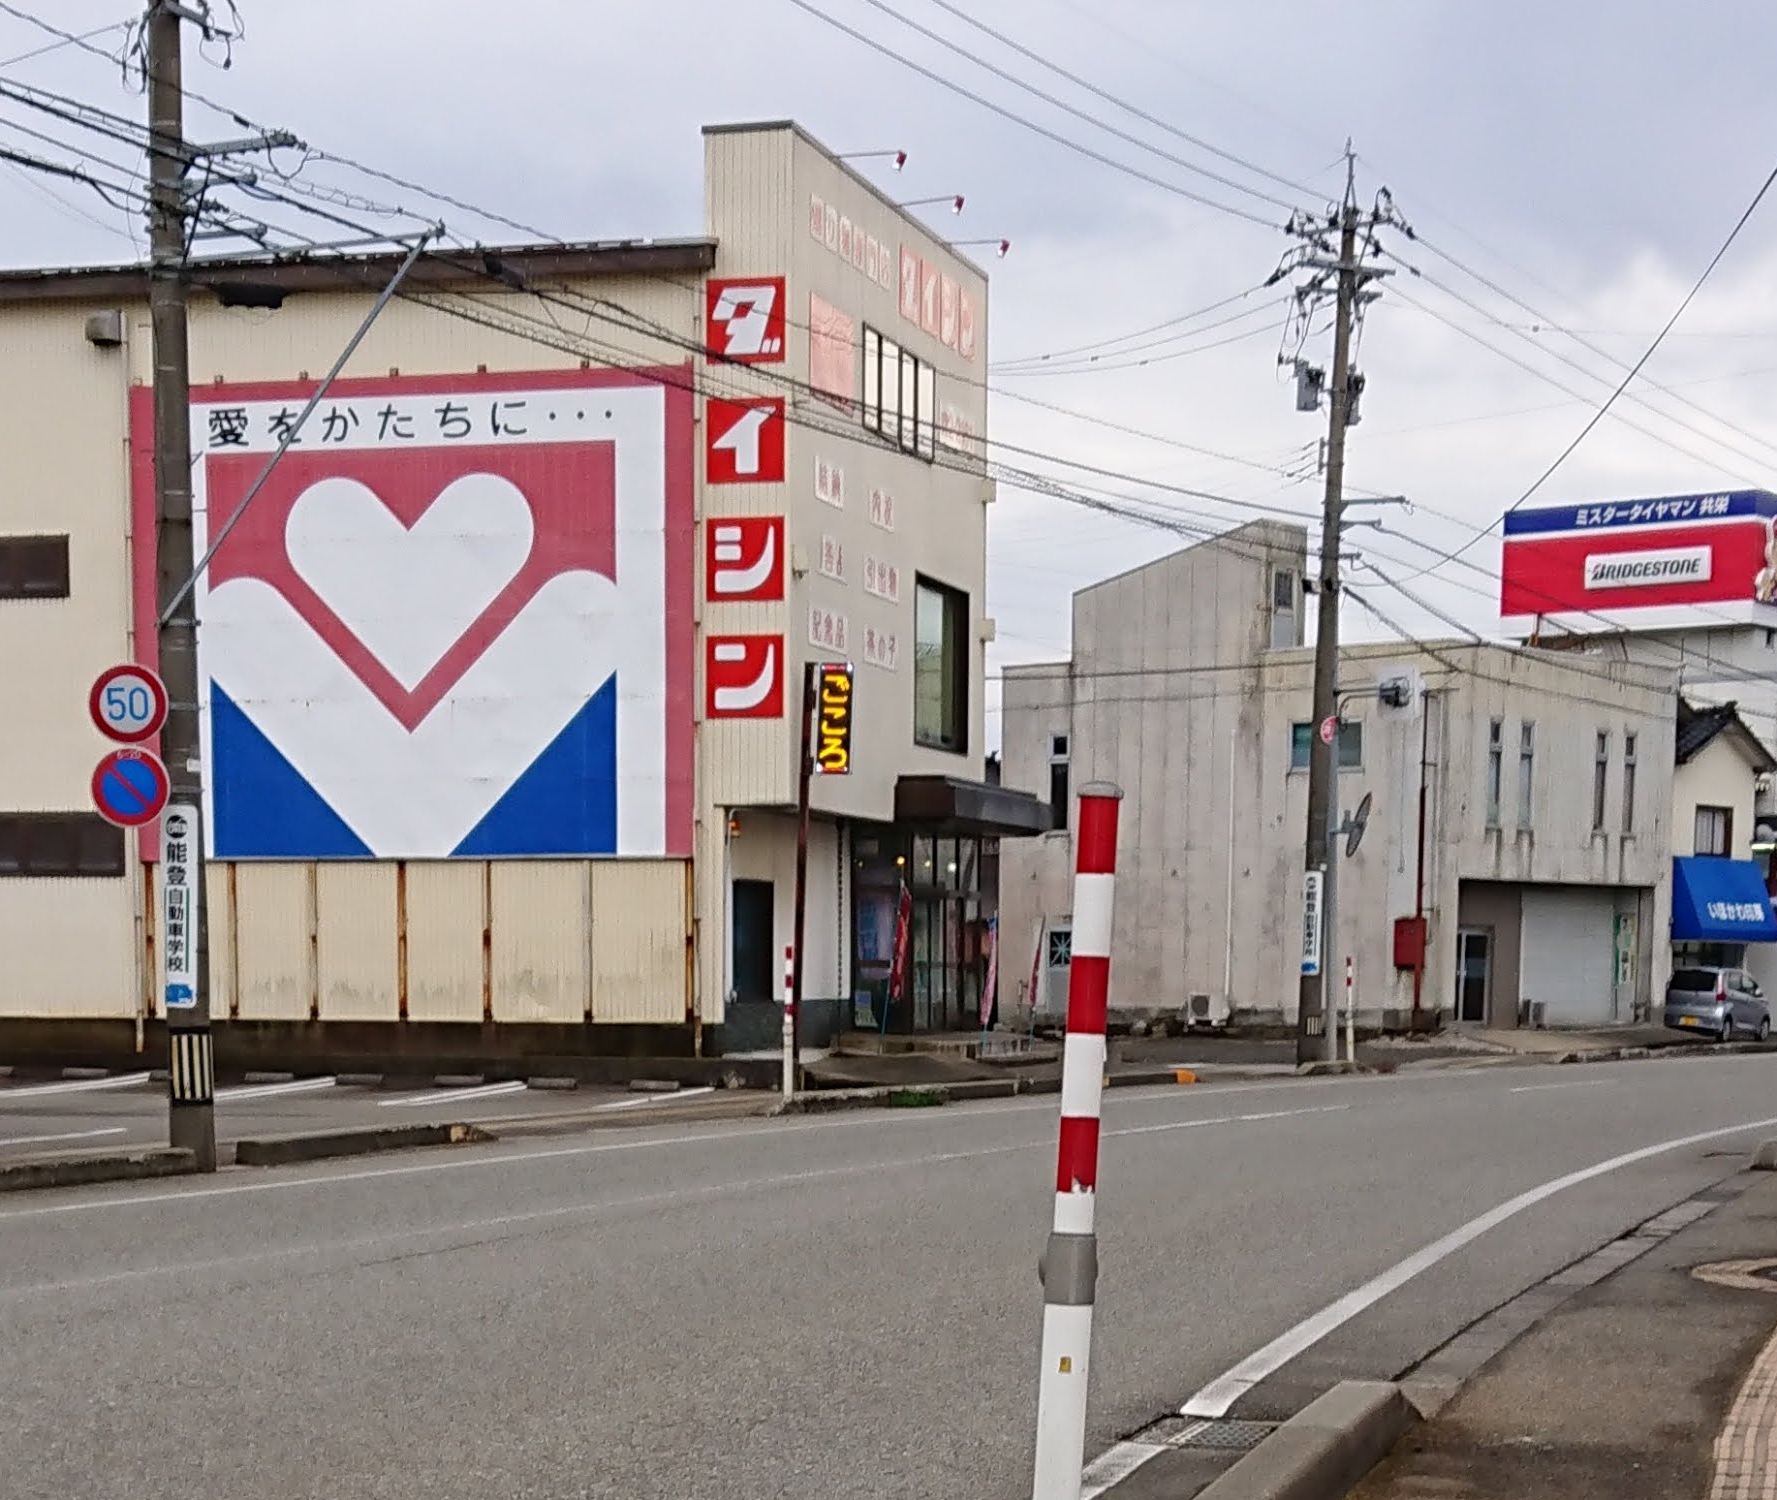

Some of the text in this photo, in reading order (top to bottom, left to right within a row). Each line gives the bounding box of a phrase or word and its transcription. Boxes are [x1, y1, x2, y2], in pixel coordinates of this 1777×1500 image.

[710, 284, 781, 711] ダイシン
[1575, 499, 1696, 526] ミスタータイヤマン
[1591, 557, 1701, 582] BRIDGESTONE
[812, 608, 845, 649] 記念品
[106, 687, 149, 721] 50
